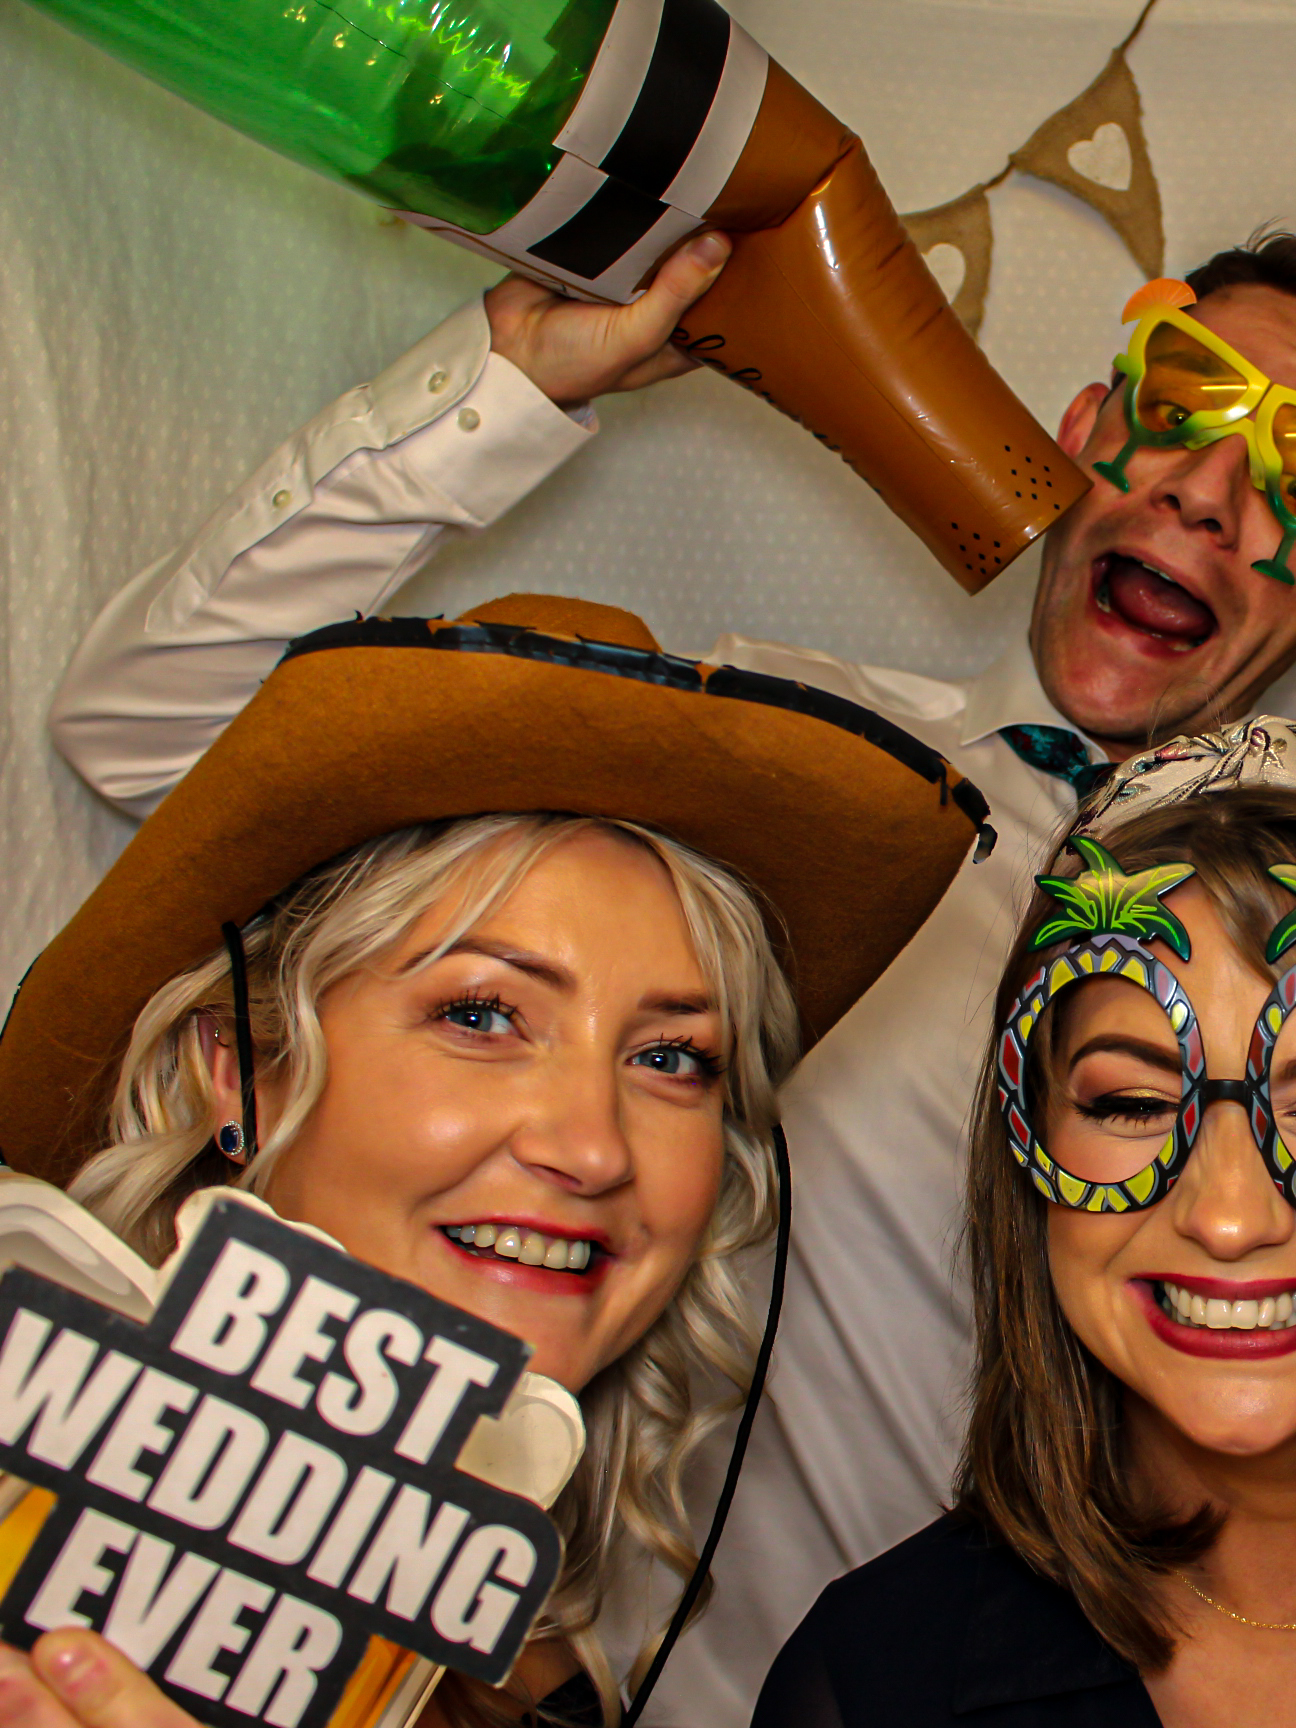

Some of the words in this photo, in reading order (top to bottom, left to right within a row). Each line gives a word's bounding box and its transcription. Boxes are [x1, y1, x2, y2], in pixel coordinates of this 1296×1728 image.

[170, 1237, 500, 1465] BEST
[0, 1307, 538, 1655] WEDDING
[24, 1506, 344, 1728] EVER
